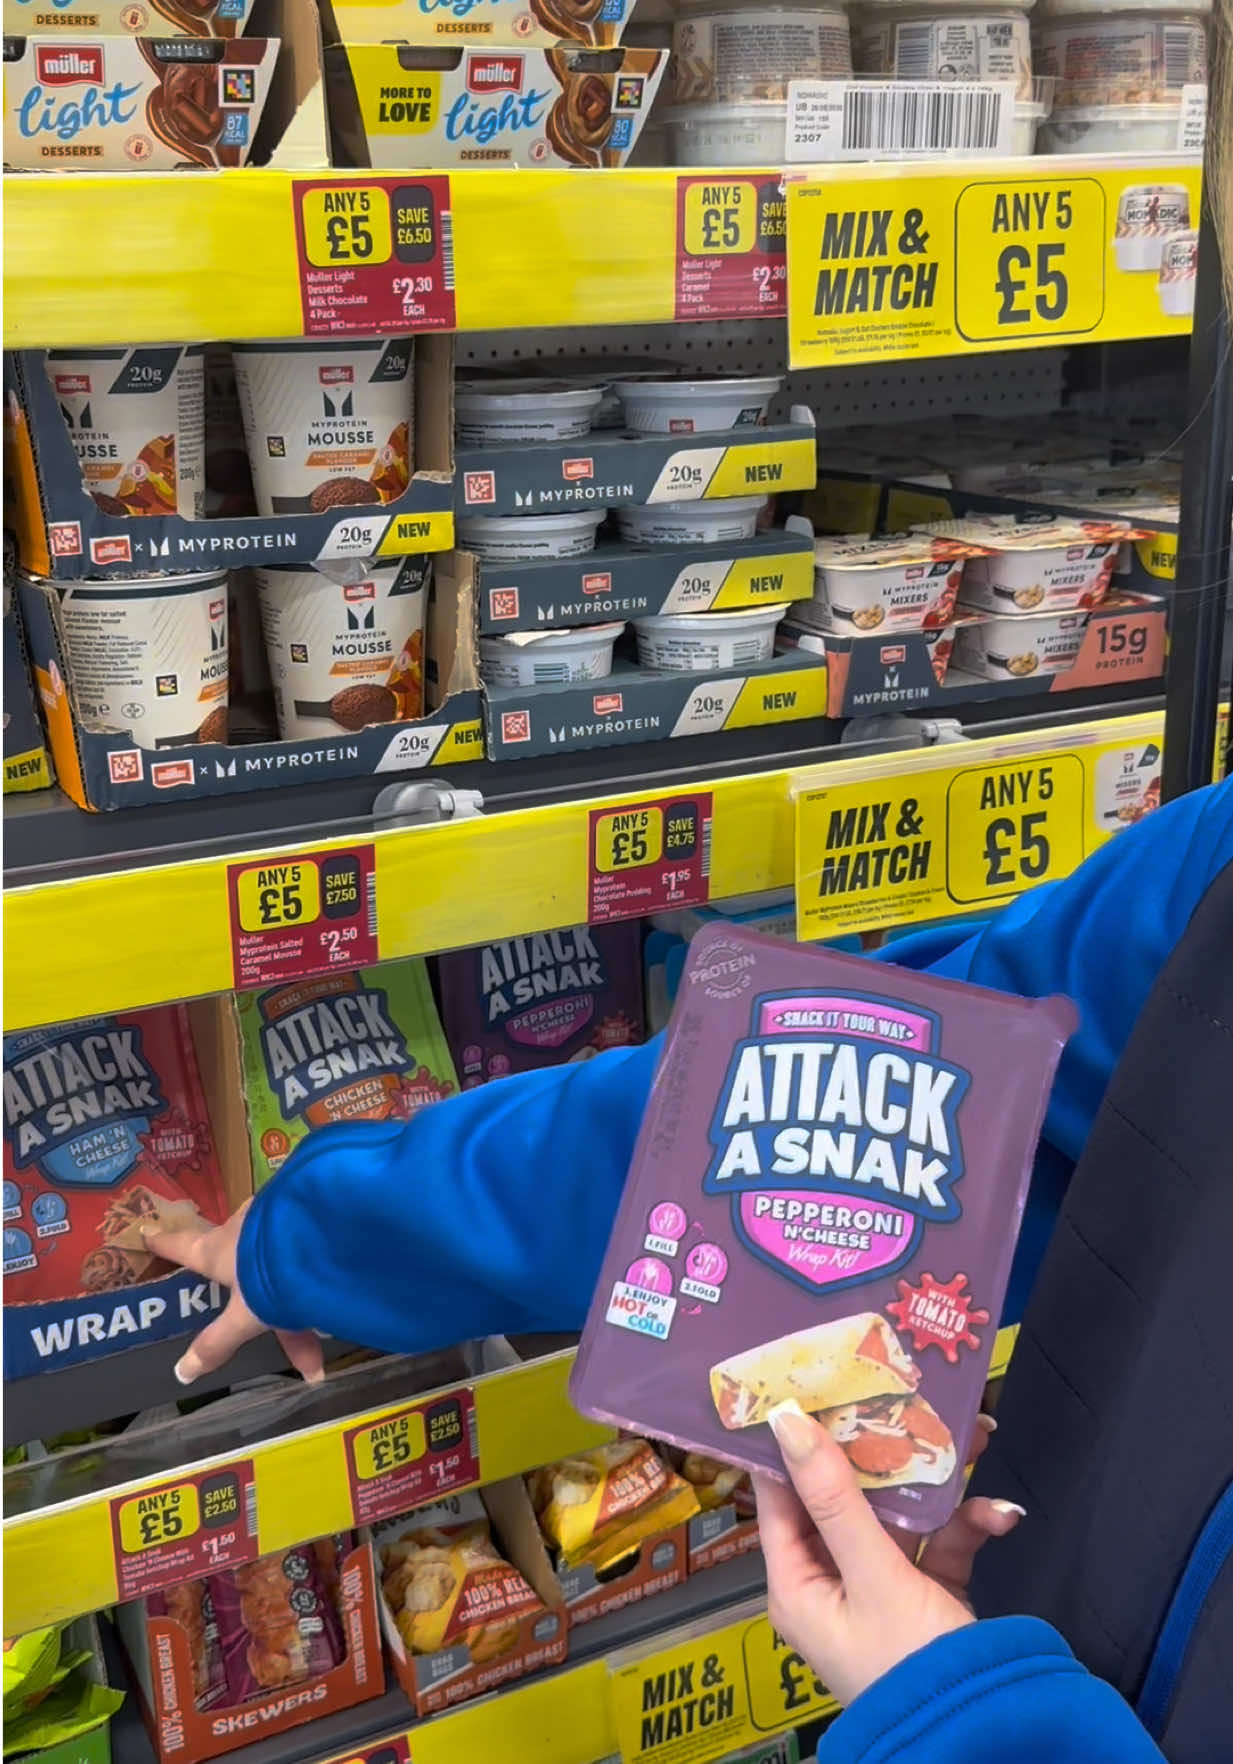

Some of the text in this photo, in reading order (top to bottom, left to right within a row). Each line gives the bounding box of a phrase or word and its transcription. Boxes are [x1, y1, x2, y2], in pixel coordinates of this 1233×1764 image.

[36, 14, 97, 26] DESSERTS
[436, 23, 491, 34] DESSERTS
[44, 53, 97, 75] müller
[473, 63, 516, 84] müller
[380, 87, 432, 99] MORE TO
[13, 82, 143, 140] light
[379, 102, 430, 123] LOVE
[444, 89, 552, 144] light
[794, 133, 822, 143] 2307
[41, 145, 102, 158] DESSERTS
[460, 150, 509, 161] DESSERTS
[324, 192, 371, 213] ANY 5
[702, 186, 741, 205] ANY 5
[397, 208, 429, 224] SAVE
[992, 190, 1072, 234] ANY 5
[326, 215, 373, 259] £5
[397, 228, 432, 244] £6.50
[702, 209, 740, 247] £5
[821, 207, 930, 260] MIX &
[334, 271, 355, 283] Light
[995, 243, 1068, 324] £5
[307, 284, 343, 294] Desserts
[392, 277, 432, 304] £2.30
[814, 262, 938, 316] MATCH
[328, 295, 368, 305] Chocolate
[403, 305, 425, 316] EACH
[316, 309, 336, 318] Pack
[130, 367, 162, 382] 20g
[308, 431, 374, 446] MOUSSE
[670, 465, 702, 483] 20g
[745, 464, 782, 483] NEW
[540, 485, 633, 502] MYPROTEIN
[340, 527, 372, 543] 20g
[398, 522, 430, 537] NEW
[178, 533, 297, 552] MYPROTEIN
[681, 578, 711, 595] 20g
[750, 575, 783, 592] NEW
[1051, 574, 1085, 585] MIXERS
[561, 598, 647, 616] MYPROTEIN
[890, 593, 929, 606] MIXERS
[332, 641, 392, 656] MOUSSE
[1097, 624, 1147, 655] 15g
[1096, 656, 1144, 670] PROTEIN
[694, 697, 723, 714] 20g
[763, 692, 797, 710] NEW
[853, 688, 929, 705] MYPROTEIN
[572, 716, 660, 737] MYPROTEIN
[399, 736, 430, 752] 20g
[7, 758, 41, 779] NEW
[245, 747, 358, 772] MYPROTEIN
[979, 768, 1053, 810] ANY 5
[612, 812, 648, 832] ANY 5
[668, 817, 694, 832] SAVE
[826, 798, 923, 850] MIX &
[612, 829, 647, 865] £5
[667, 832, 695, 847] £4.75
[983, 811, 1051, 886] £5
[258, 866, 301, 888] ANY 5
[818, 840, 931, 897] MATCH
[326, 872, 356, 889] SAVE
[662, 869, 690, 890] £1.95
[259, 885, 302, 924] £5
[326, 888, 357, 905] £7.50
[320, 927, 357, 952] £2.50
[240, 949, 302, 965] Caramel Mousse
[329, 952, 350, 962] EACH
[481, 926, 599, 994] ATTACK
[689, 953, 756, 984] PROTEIN
[489, 962, 603, 1021] A SNAK
[513, 997, 589, 1030] PEPPERONI
[783, 1011, 906, 1040] SNACK IT YOUR WAY
[265, 995, 395, 1079] ATTACK
[3, 1031, 148, 1127] ATTACK
[284, 1040, 407, 1109] A SNAK
[324, 1079, 383, 1110] CHICKEN
[343, 1092, 387, 1117] CHEESE
[723, 1042, 956, 1156] ATTACK
[20, 1080, 160, 1158] A SNAK
[70, 1134, 106, 1155] HAM
[151, 1134, 195, 1152] TOMATO
[75, 1140, 129, 1168] CHEESE
[716, 1127, 949, 1207] A SNAK
[754, 1195, 904, 1236] PEPPERONI
[784, 1224, 871, 1250] N'CHEESE
[788, 1244, 827, 1273] Wrap
[684, 1282, 716, 1298] 2.FOLD
[928, 1288, 956, 1307] WITH
[612, 1296, 647, 1315] HOT
[909, 1292, 966, 1333] TOMATO
[30, 1283, 221, 1357] WRAP KI
[628, 1315, 666, 1334] COLD
[909, 1315, 955, 1340] KETCHUP
[370, 1418, 408, 1443] ANY 5
[430, 1411, 457, 1429] SAVE
[431, 1424, 460, 1442] £2.50
[373, 1432, 410, 1471] £5
[138, 1490, 180, 1514] ANY 5
[205, 1485, 234, 1504] SAVE
[204, 1499, 237, 1518] £2.50
[140, 1506, 182, 1544] £5
[343, 1565, 364, 1611] 100%
[464, 1584, 502, 1607] 100%
[459, 1601, 506, 1622] CHICKEN
[161, 1670, 178, 1711] CHICKEN
[642, 1654, 724, 1713] MIX &
[212, 1683, 328, 1736] SKEWERS
[640, 1684, 734, 1751] MATCH
[162, 1710, 184, 1753] 100%
